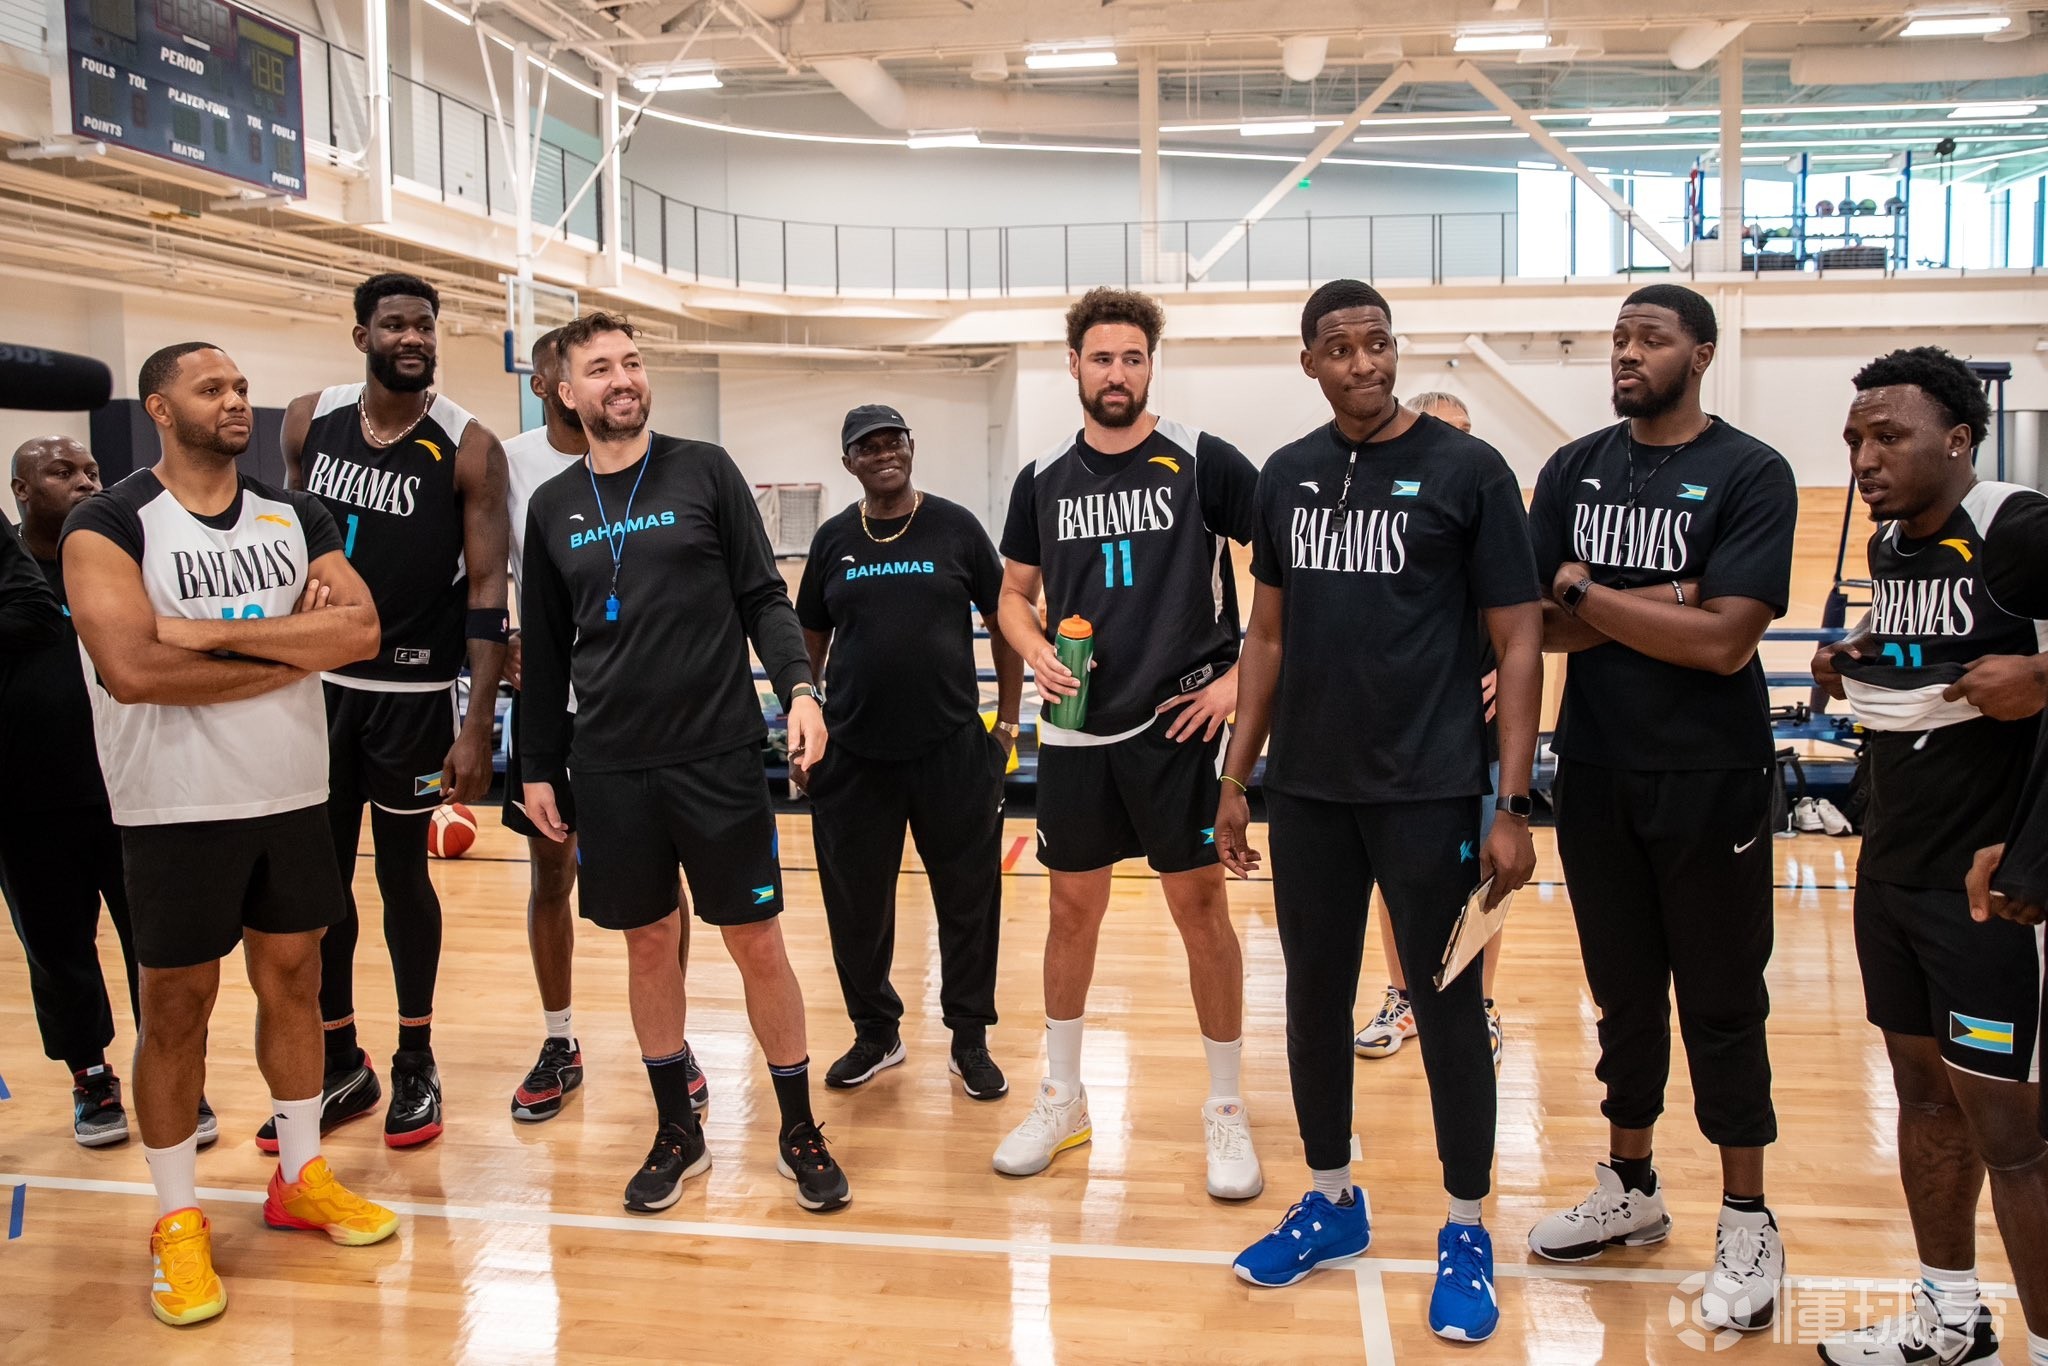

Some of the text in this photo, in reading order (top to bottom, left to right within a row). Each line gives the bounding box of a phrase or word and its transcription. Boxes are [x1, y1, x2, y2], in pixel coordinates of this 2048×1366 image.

[81, 57, 116, 79] FOULS
[160, 47, 205, 75] PERIOD
[128, 73, 148, 91] TOL
[168, 87, 231, 119] PLAYER-FOUL
[83, 115, 122, 137] POINTS
[247, 115, 263, 130] TOL
[272, 123, 297, 141] FOULS
[172, 142, 205, 161] MATCH
[272, 172, 300, 189] POINTS
[307, 452, 421, 517] BAHAMAS
[570, 510, 675, 549] BAHAMAS
[1057, 486, 1174, 541] BAHAMAS
[344, 514, 359, 559] 1
[1291, 507, 1408, 574] BAHAMAS
[1573, 503, 1692, 572] BAHAMAS
[170, 539, 296, 601] BAHAMAS
[846, 561, 934, 580] BAHAMAS
[1101, 540, 1133, 588] 11
[1870, 577, 1974, 636] BAHAMAS
